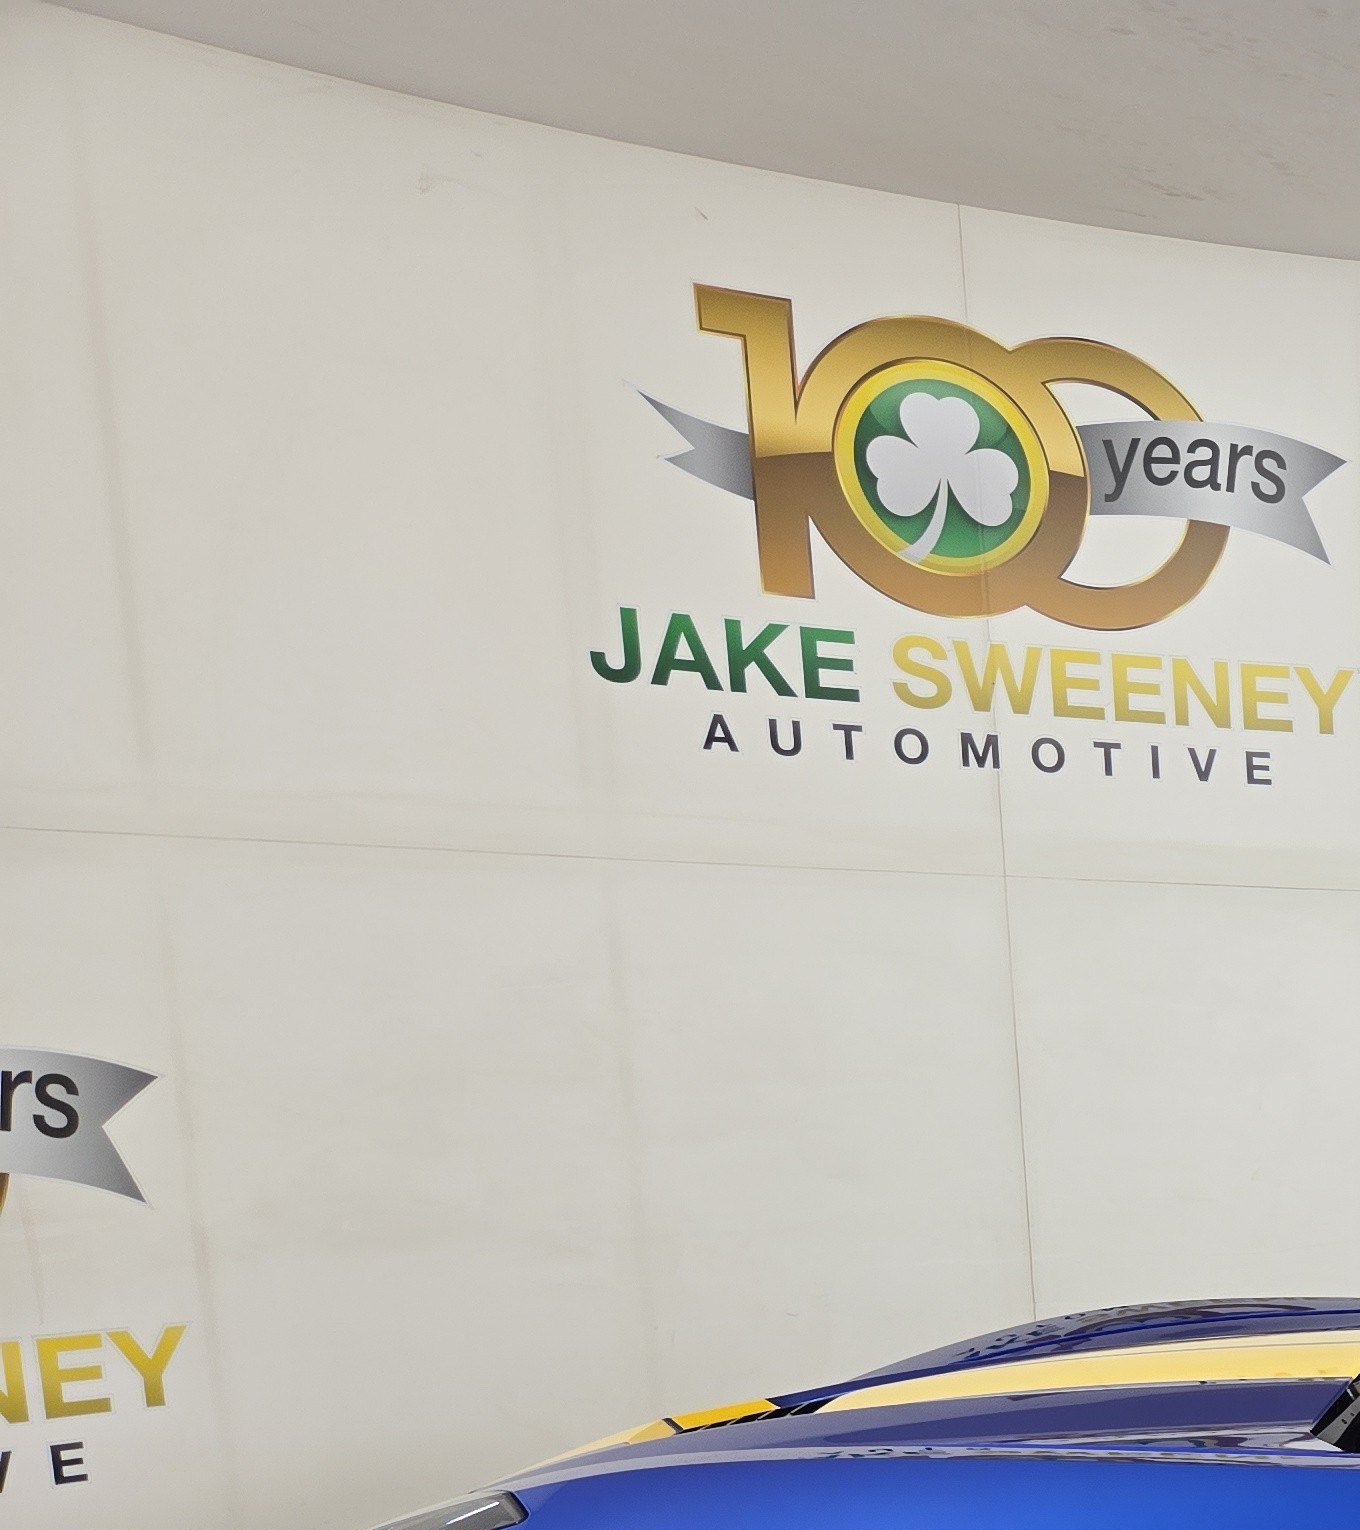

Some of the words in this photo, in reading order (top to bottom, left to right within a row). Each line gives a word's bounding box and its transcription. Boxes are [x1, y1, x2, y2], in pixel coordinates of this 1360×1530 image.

[694, 282, 1231, 631] 100
[1103, 436, 1287, 504] years
[589, 607, 860, 702] JAKE
[893, 634, 1356, 735] SWEENEY
[703, 713, 1273, 785] AUTOMOTIVE
